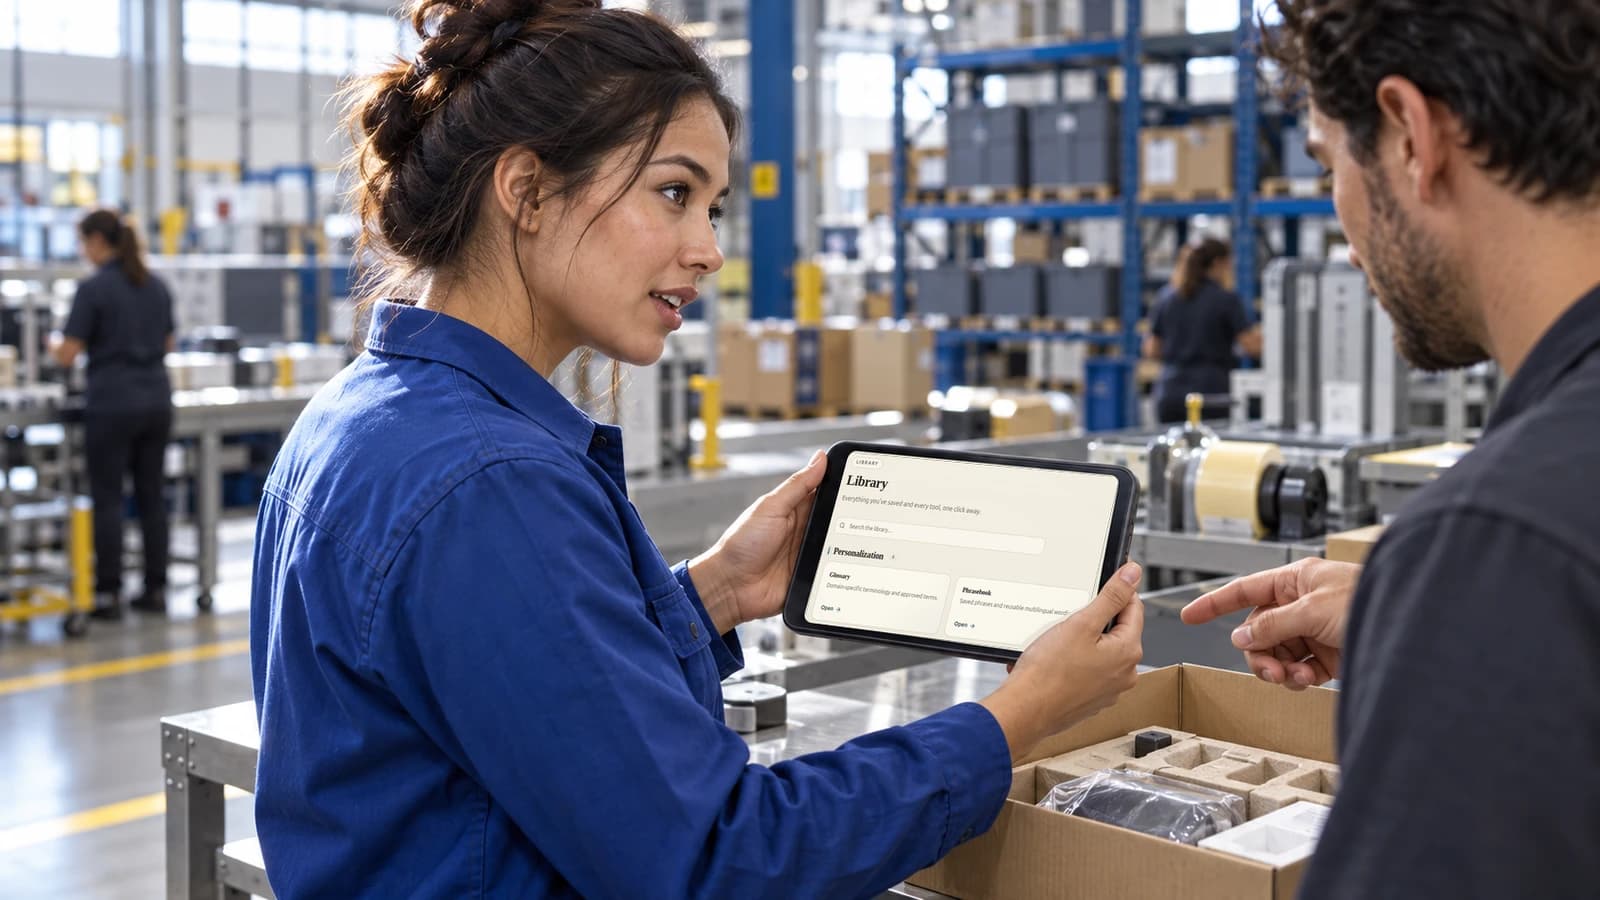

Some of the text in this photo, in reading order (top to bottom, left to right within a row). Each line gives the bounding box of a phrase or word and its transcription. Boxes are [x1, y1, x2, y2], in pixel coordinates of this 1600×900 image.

[846, 474, 889, 492] Library
[842, 495, 869, 504] Everything
[870, 497, 887, 505] you've
[914, 503, 929, 511] every
[849, 523, 864, 531] Search
[833, 547, 884, 560] Personalization
[829, 572, 851, 581] Glossary
[863, 586, 891, 596] terminology
[900, 592, 923, 600] approved
[962, 587, 992, 596] Phrasebook
[820, 604, 834, 612] Open
[959, 598, 975, 606] Saved
[974, 600, 993, 608] phrases
[1004, 603, 1025, 611] reusable
[1024, 605, 1054, 615] multilingual
[953, 620, 968, 629] Open
